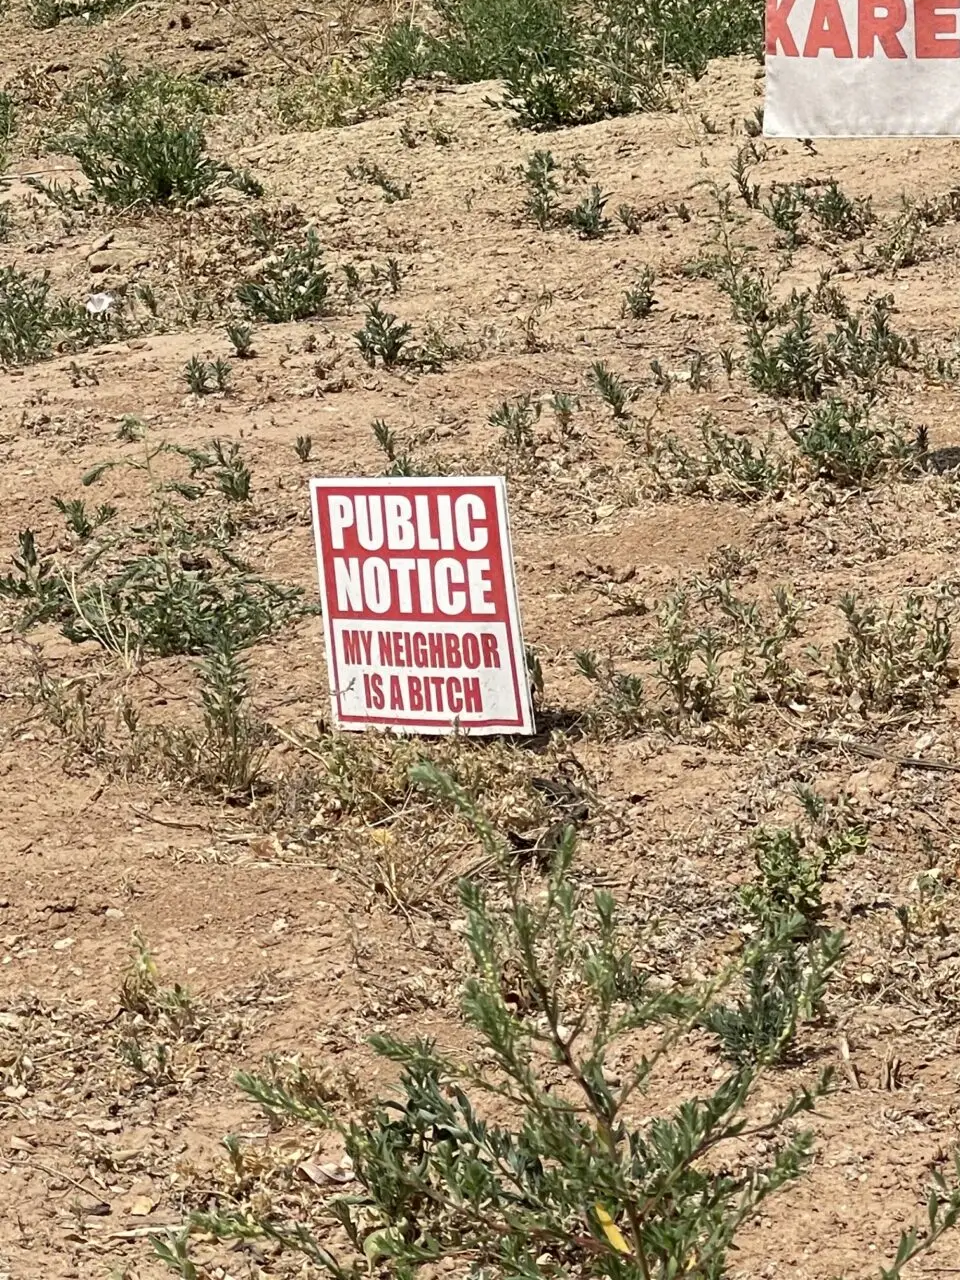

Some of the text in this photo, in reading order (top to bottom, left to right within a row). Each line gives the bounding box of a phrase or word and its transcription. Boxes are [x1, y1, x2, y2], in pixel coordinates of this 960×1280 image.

[328, 494, 489, 552] PUBLIC
[333, 556, 496, 615] NOTICE
[341, 629, 501, 669] MY NEIGHBOR
[363, 673, 483, 713] IS A BITCH
